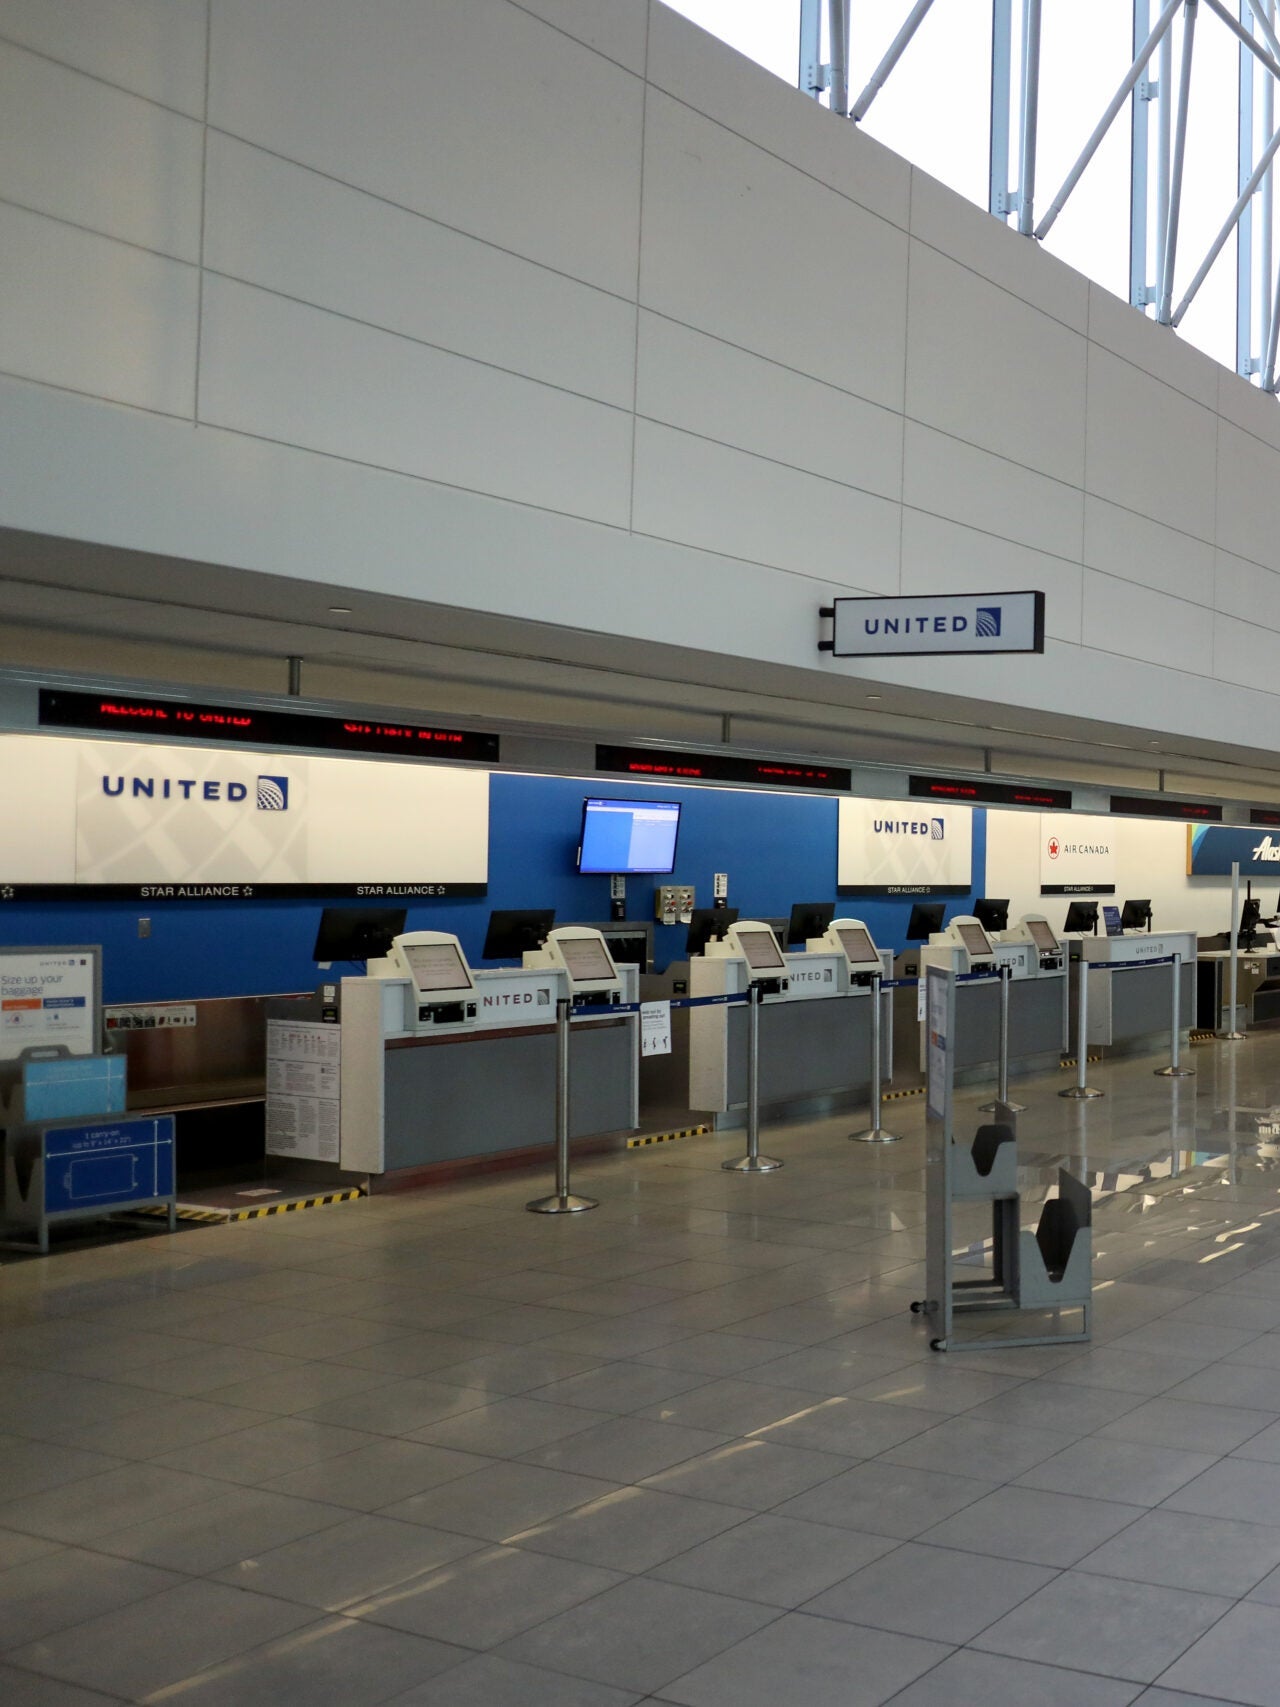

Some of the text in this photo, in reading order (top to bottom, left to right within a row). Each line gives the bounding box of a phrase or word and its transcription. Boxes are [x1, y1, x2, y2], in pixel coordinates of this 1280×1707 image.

[864, 615, 968, 635] UNITED
[102, 775, 248, 802] UNITED
[873, 819, 929, 835] UNITED
[1064, 844, 1110, 855] AIR CANADA
[141, 886, 240, 897] STAR ALLIANCE
[356, 885, 435, 895] STAR ALLIANCE
[887, 886, 927, 894] STAR ALLIANCE
[1, 975, 64, 985] Size up your
[790, 971, 821, 982] NITED
[1, 986, 44, 997] baggage
[483, 992, 533, 1008] NITED
